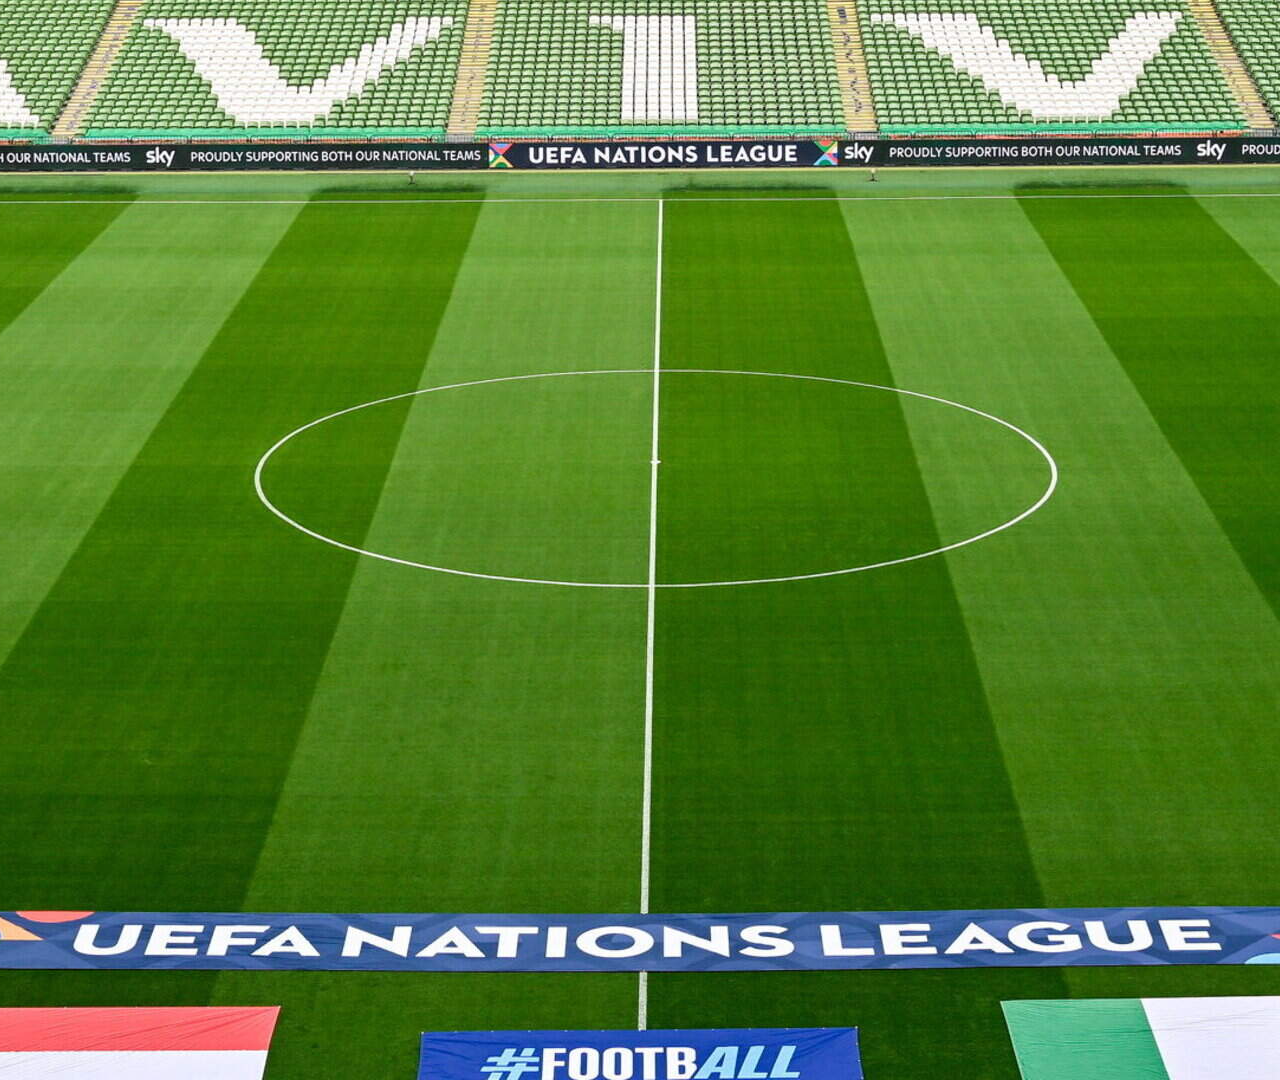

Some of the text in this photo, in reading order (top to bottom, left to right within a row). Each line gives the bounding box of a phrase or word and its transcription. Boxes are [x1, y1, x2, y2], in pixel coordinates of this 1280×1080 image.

[7, 153, 31, 163] OUR
[34, 153, 90, 163] NATIONAL
[93, 152, 131, 162] TEAMS
[146, 147, 480, 167] sky PROUDLY SUPPORTING BOTH OUR NATIONAL TEAMS
[529, 145, 797, 163] UEFA NATIONS LEAGUE
[845, 143, 1181, 163] sky PROUDLY SUPPORTING BOTH OUR NATIONAL TEAMS
[1197, 140, 1226, 160] sky
[73, 919, 1222, 958] UEFA NATIONS LEAGUE
[480, 1045, 800, 1080] #FOOTBALL
